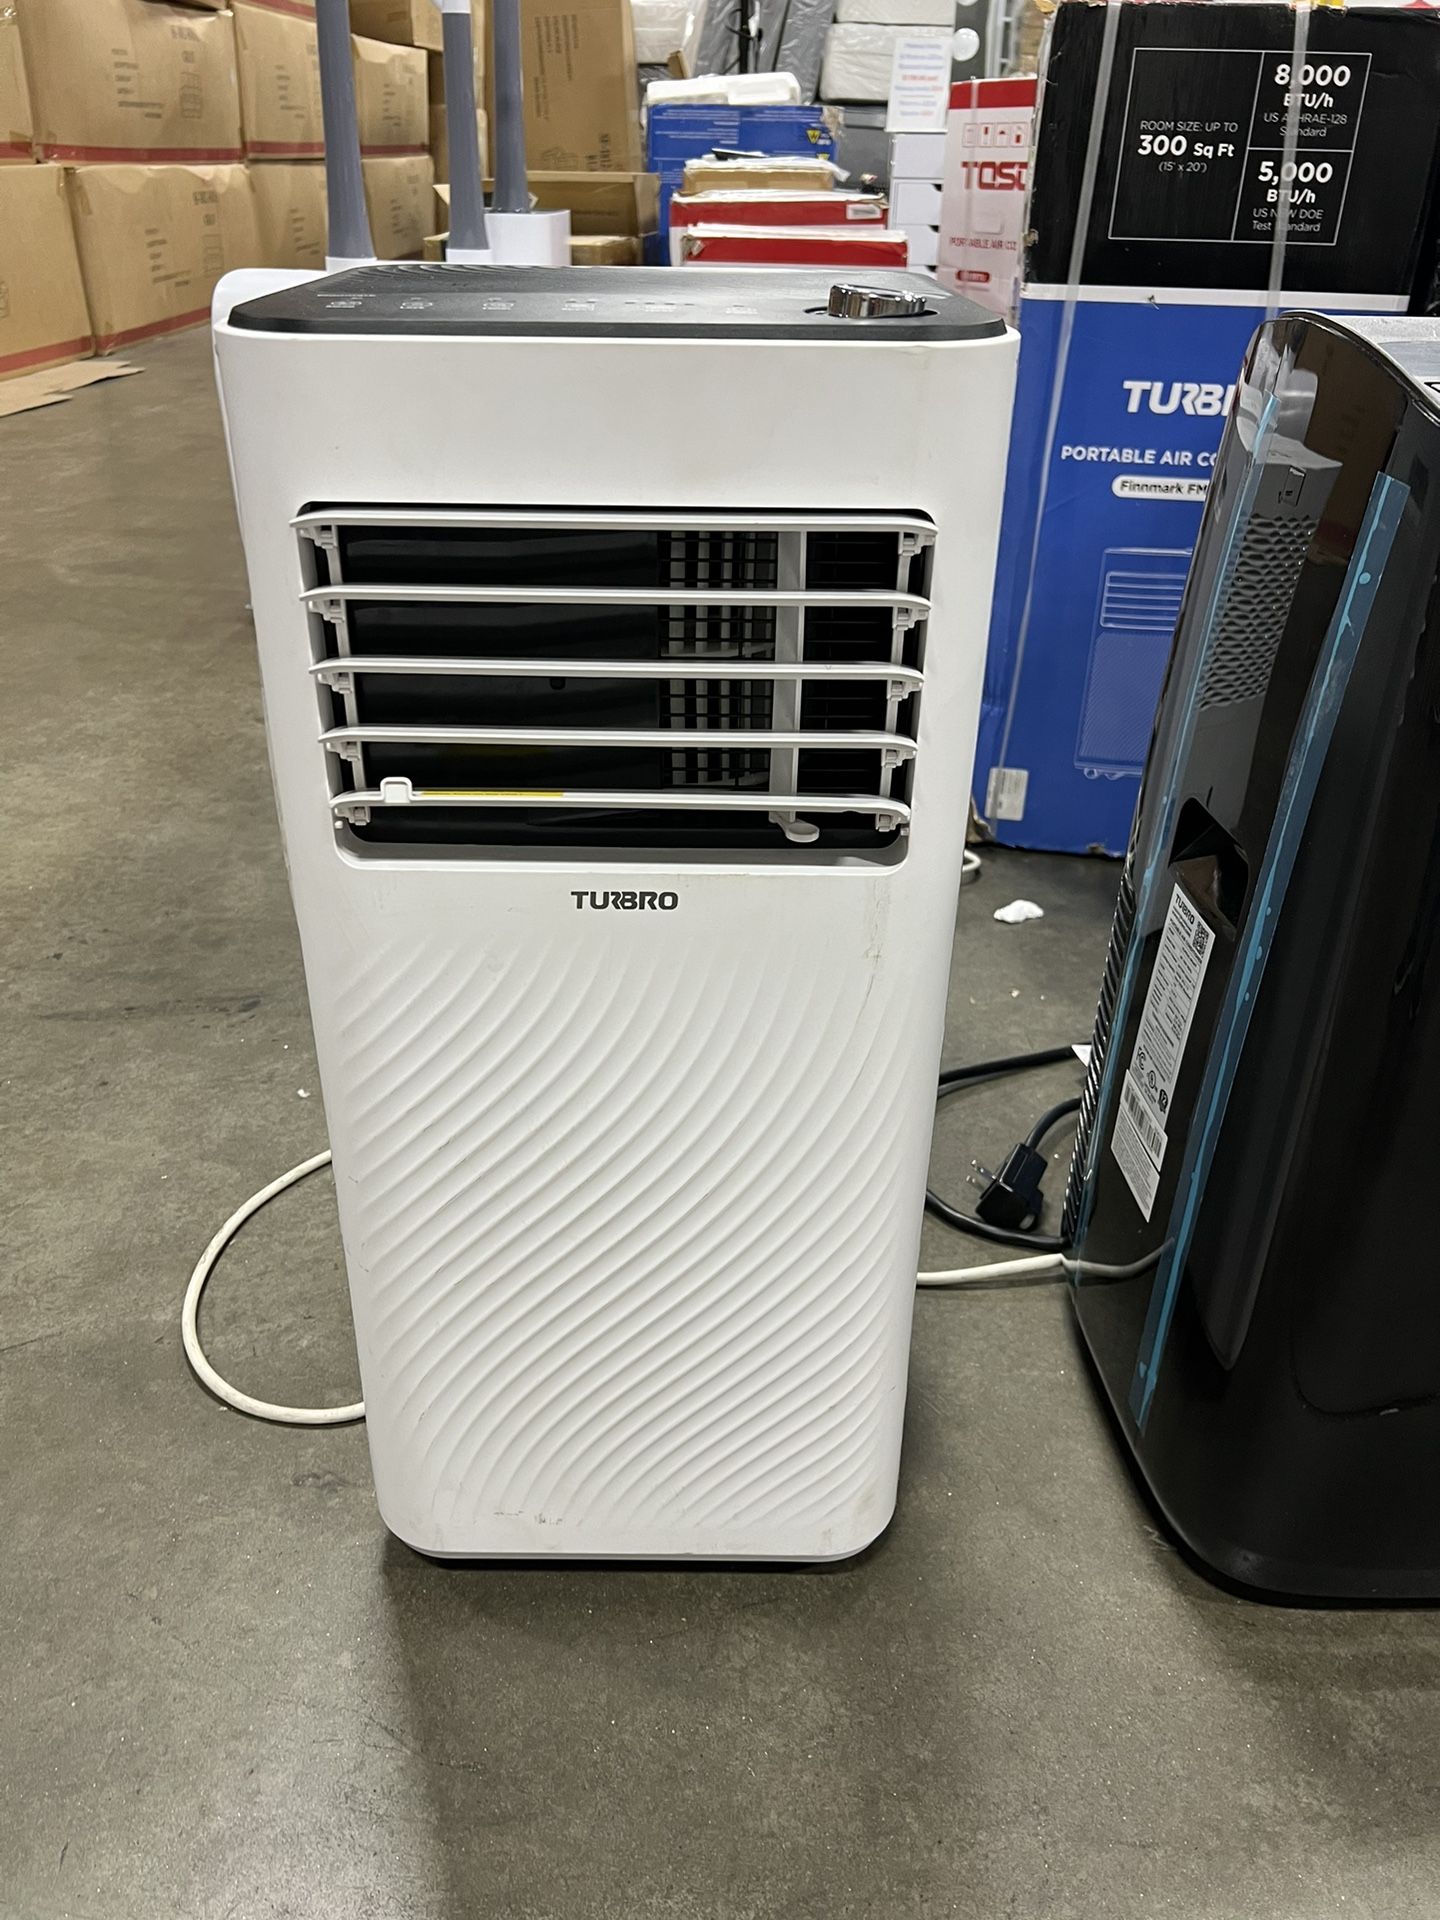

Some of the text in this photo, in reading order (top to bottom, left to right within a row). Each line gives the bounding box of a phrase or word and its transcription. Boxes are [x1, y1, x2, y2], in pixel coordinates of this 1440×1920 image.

[1283, 92, 1334, 109] BTU/h
[1140, 120, 1174, 131] ROOM
[1205, 122, 1221, 132] UP
[1224, 122, 1238, 132] TO
[1264, 112, 1347, 125] US AHRAE-128
[1280, 126, 1327, 137] Sndard
[1138, 134, 1235, 159] 300 Sq Ft
[1258, 161, 1333, 185] 5,000
[1267, 188, 1316, 205] BTU/h
[1253, 208, 1324, 219] US NW DOE
[1253, 220, 1272, 231] Test
[1060, 445, 1157, 464] PORTABLE
[1160, 450, 1193, 466] AIR
[1120, 480, 1183, 494] Finnmark
[571, 891, 678, 910] TURBRO
[1175, 893, 1195, 925] TURBRO
